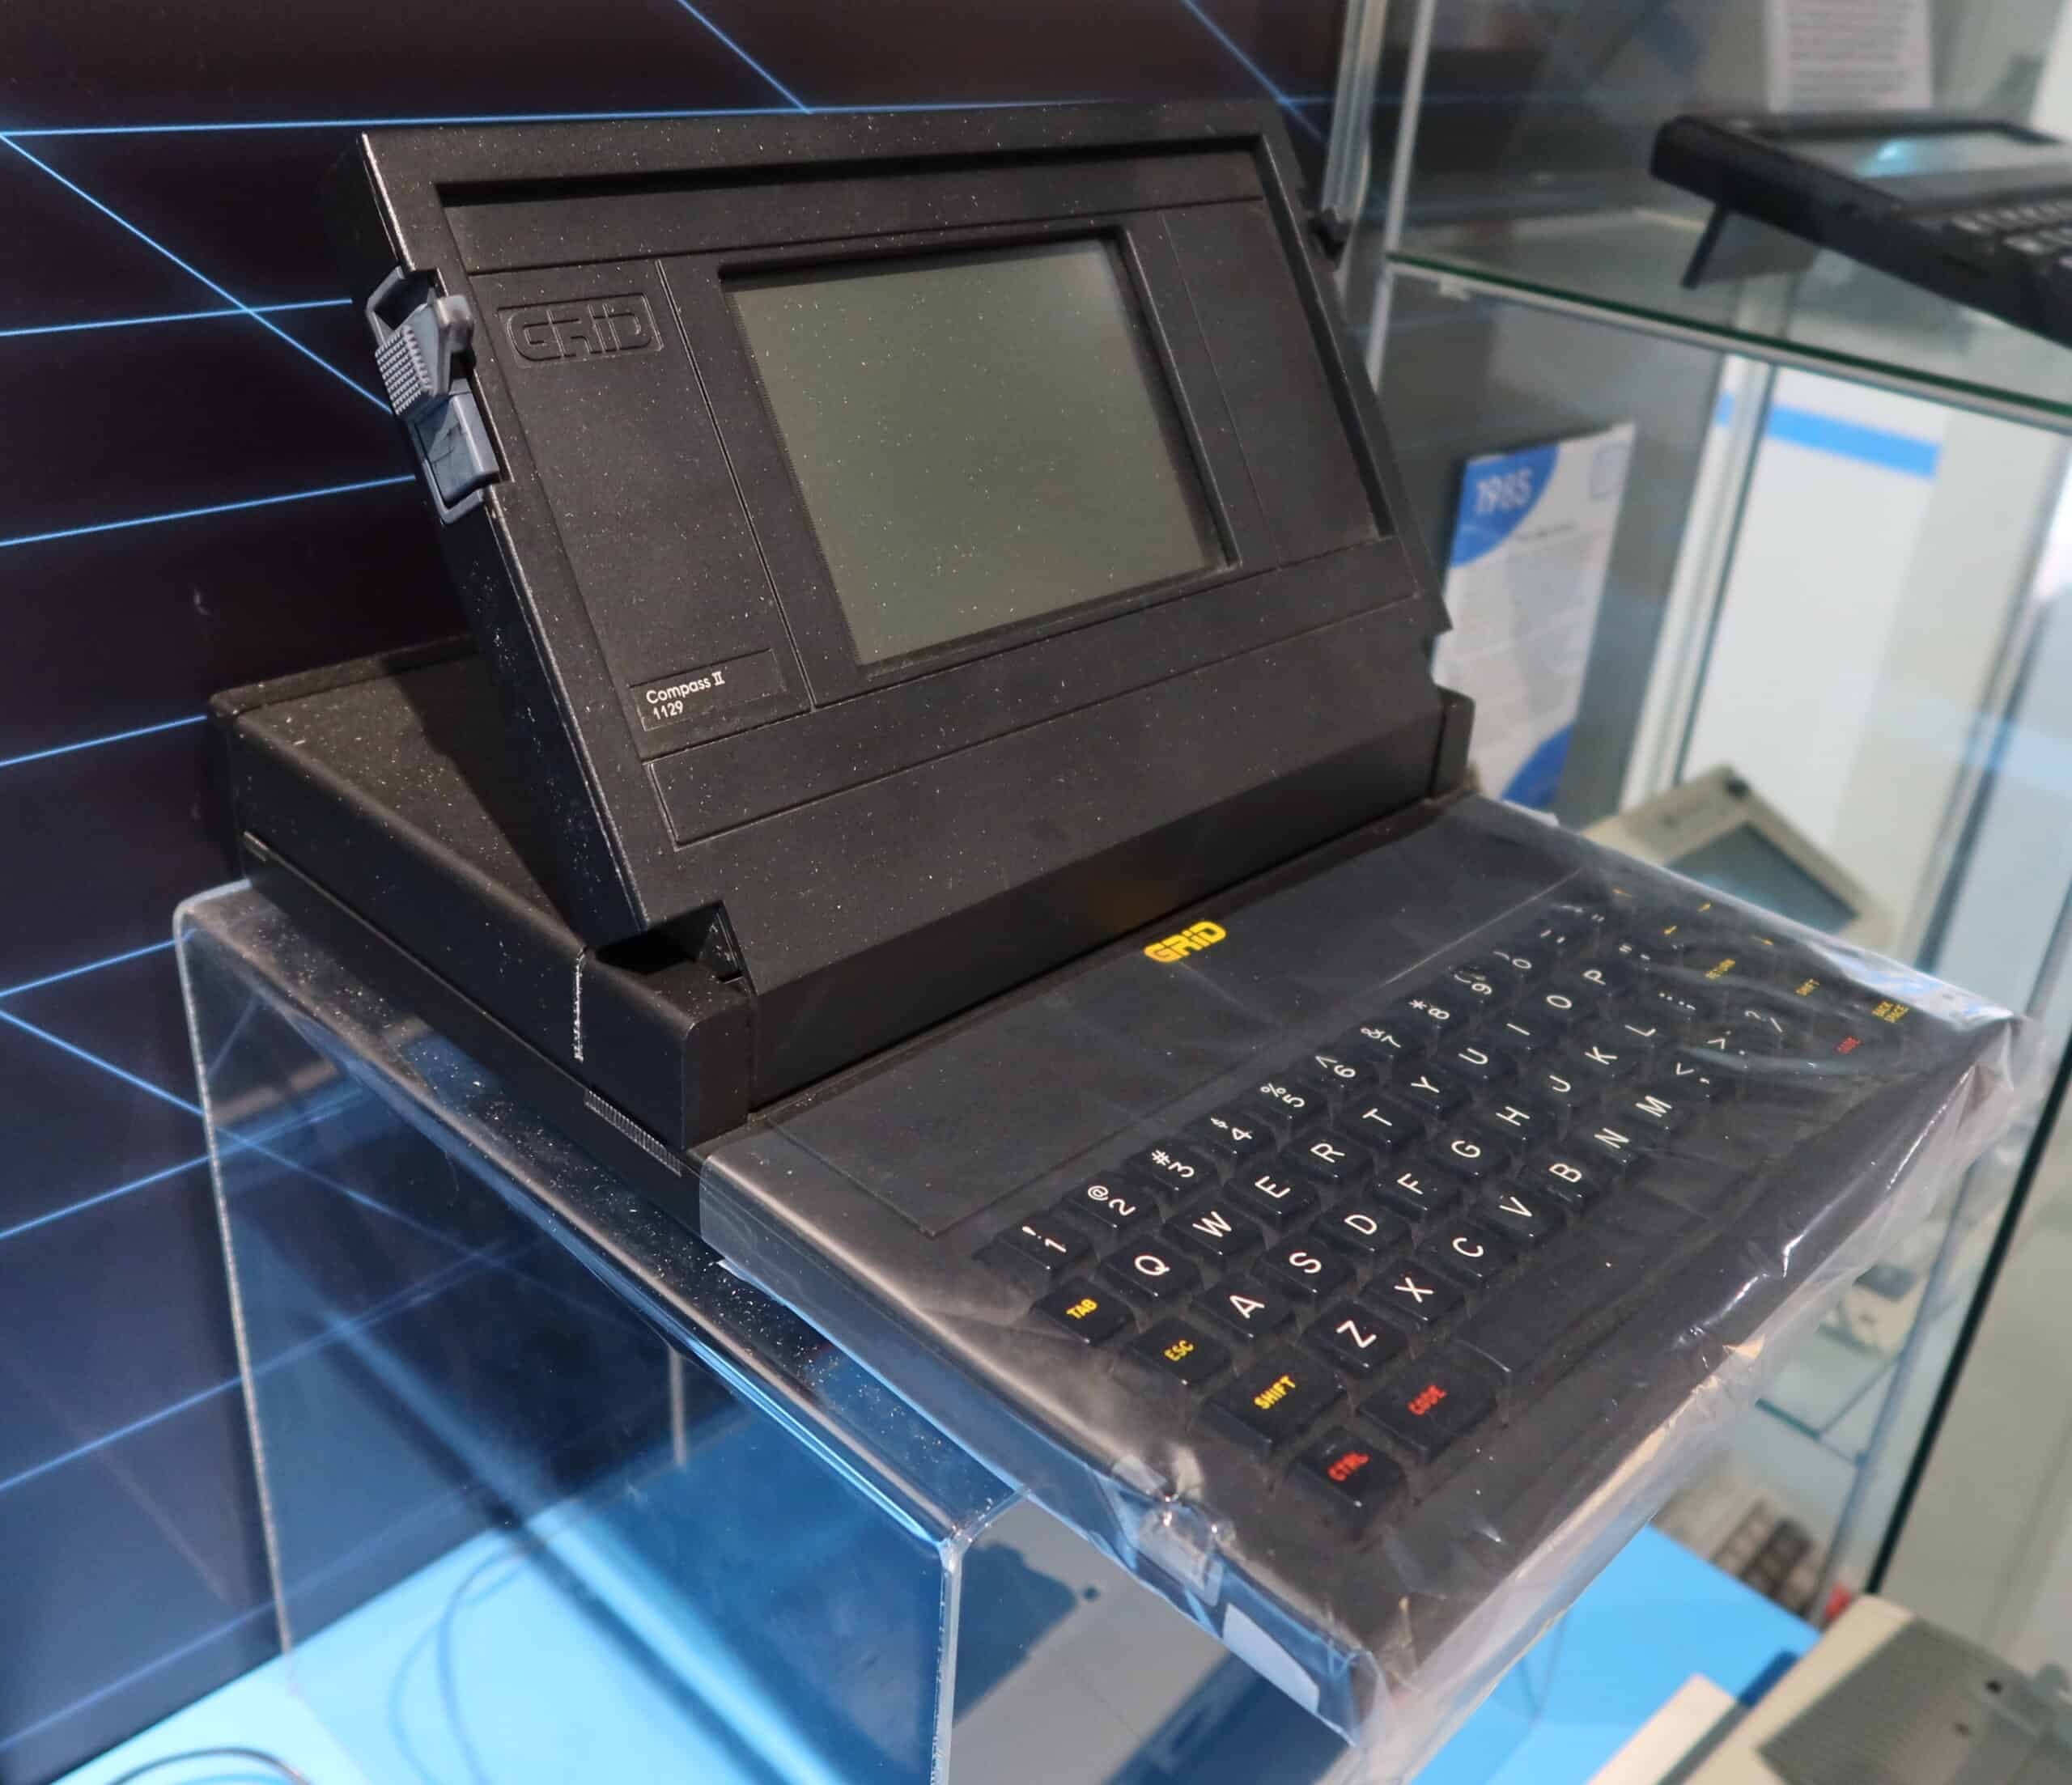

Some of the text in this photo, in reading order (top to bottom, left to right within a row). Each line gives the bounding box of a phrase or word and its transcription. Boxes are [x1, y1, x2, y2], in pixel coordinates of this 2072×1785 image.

[646, 678, 711, 703] Compass
[653, 701, 683, 719] 1129
[1512, 957, 1531, 970] 0
[1583, 969, 1606, 985] P
[1471, 982, 1492, 995] 9
[1547, 995, 1572, 1008] O
[1429, 1007, 1450, 1020] 8
[1507, 1024, 1530, 1036] I
[1625, 1025, 1656, 1037] L
[1381, 1035, 1401, 1048] 7
[1458, 1048, 1488, 1064] U
[1585, 1046, 1617, 1065] K
[1333, 1064, 1356, 1079] 6
[1412, 1076, 1439, 1093] Y
[1550, 1075, 1571, 1092] J
[1282, 1093, 1305, 1108] 5
[1636, 1096, 1672, 1117] M
[1363, 1109, 1392, 1126] T
[1496, 1107, 1530, 1126] H
[1232, 1128, 1252, 1140] 4
[1594, 1128, 1629, 1148] N
[1310, 1143, 1344, 1163] R
[1451, 1141, 1480, 1158] G
[1168, 1162, 1194, 1177] 3
[1549, 1164, 1582, 1182] B
[1255, 1177, 1290, 1198] E
[1397, 1173, 1423, 1194] F
[1109, 1198, 1136, 1215] 2
[1500, 1197, 1532, 1217] V
[1193, 1211, 1231, 1237] W
[1344, 1215, 1377, 1235] D
[1045, 1239, 1066, 1253] 1
[1453, 1237, 1484, 1257] C
[1135, 1255, 1170, 1275] Q
[1289, 1252, 1321, 1273] S
[1395, 1278, 1433, 1303] X
[1067, 1299, 1097, 1318] TAB
[1230, 1295, 1264, 1318] A
[1336, 1321, 1376, 1348] Z
[1165, 1340, 1193, 1361] ESC
[1255, 1376, 1295, 1409] SHIFT
[1408, 1385, 1446, 1415] CODE
[1327, 1450, 1369, 1481] CTRL
